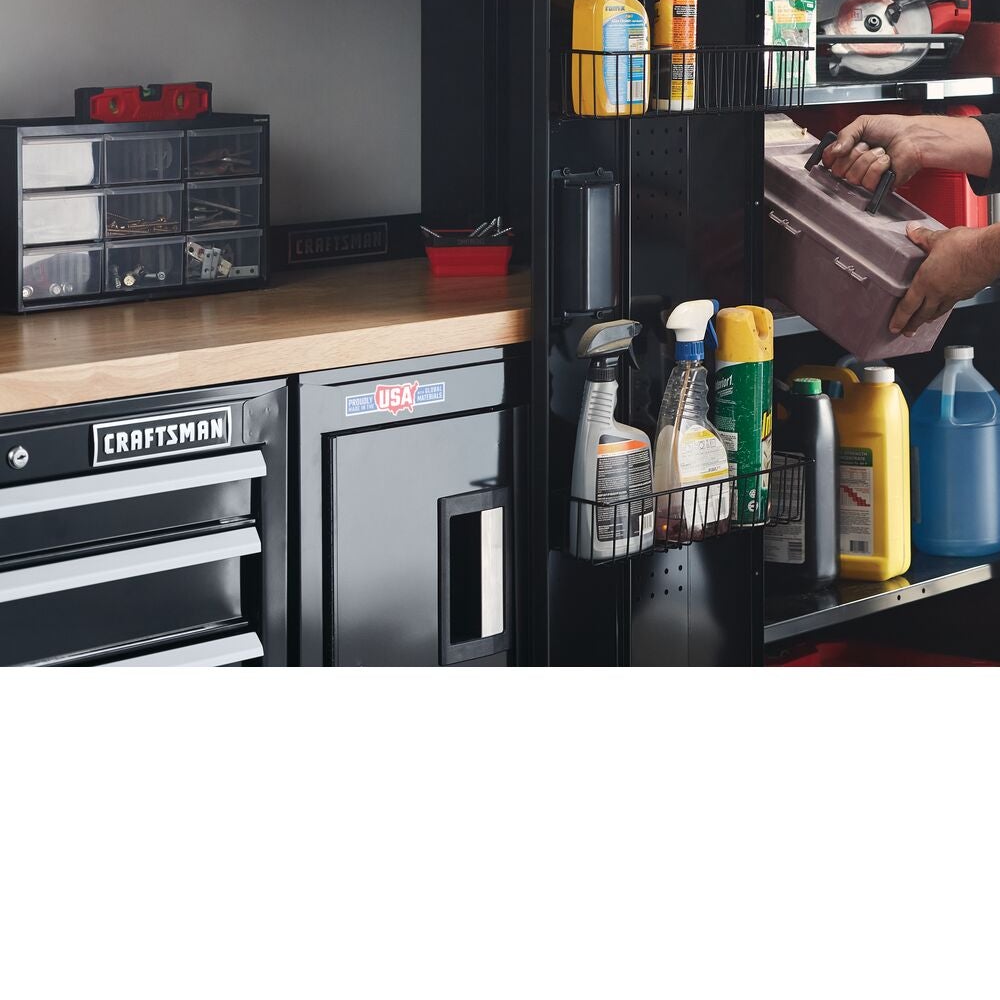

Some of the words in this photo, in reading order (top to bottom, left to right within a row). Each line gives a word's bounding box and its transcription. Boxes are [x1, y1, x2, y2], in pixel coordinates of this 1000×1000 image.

[295, 231, 382, 255] CRAFTSMAN
[379, 386, 413, 409] USA
[417, 391, 443, 401] MATERIALS
[424, 385, 443, 393] GLOBAL
[348, 395, 373, 407] PROUDLY
[104, 418, 223, 455] CRAFTSMAN
